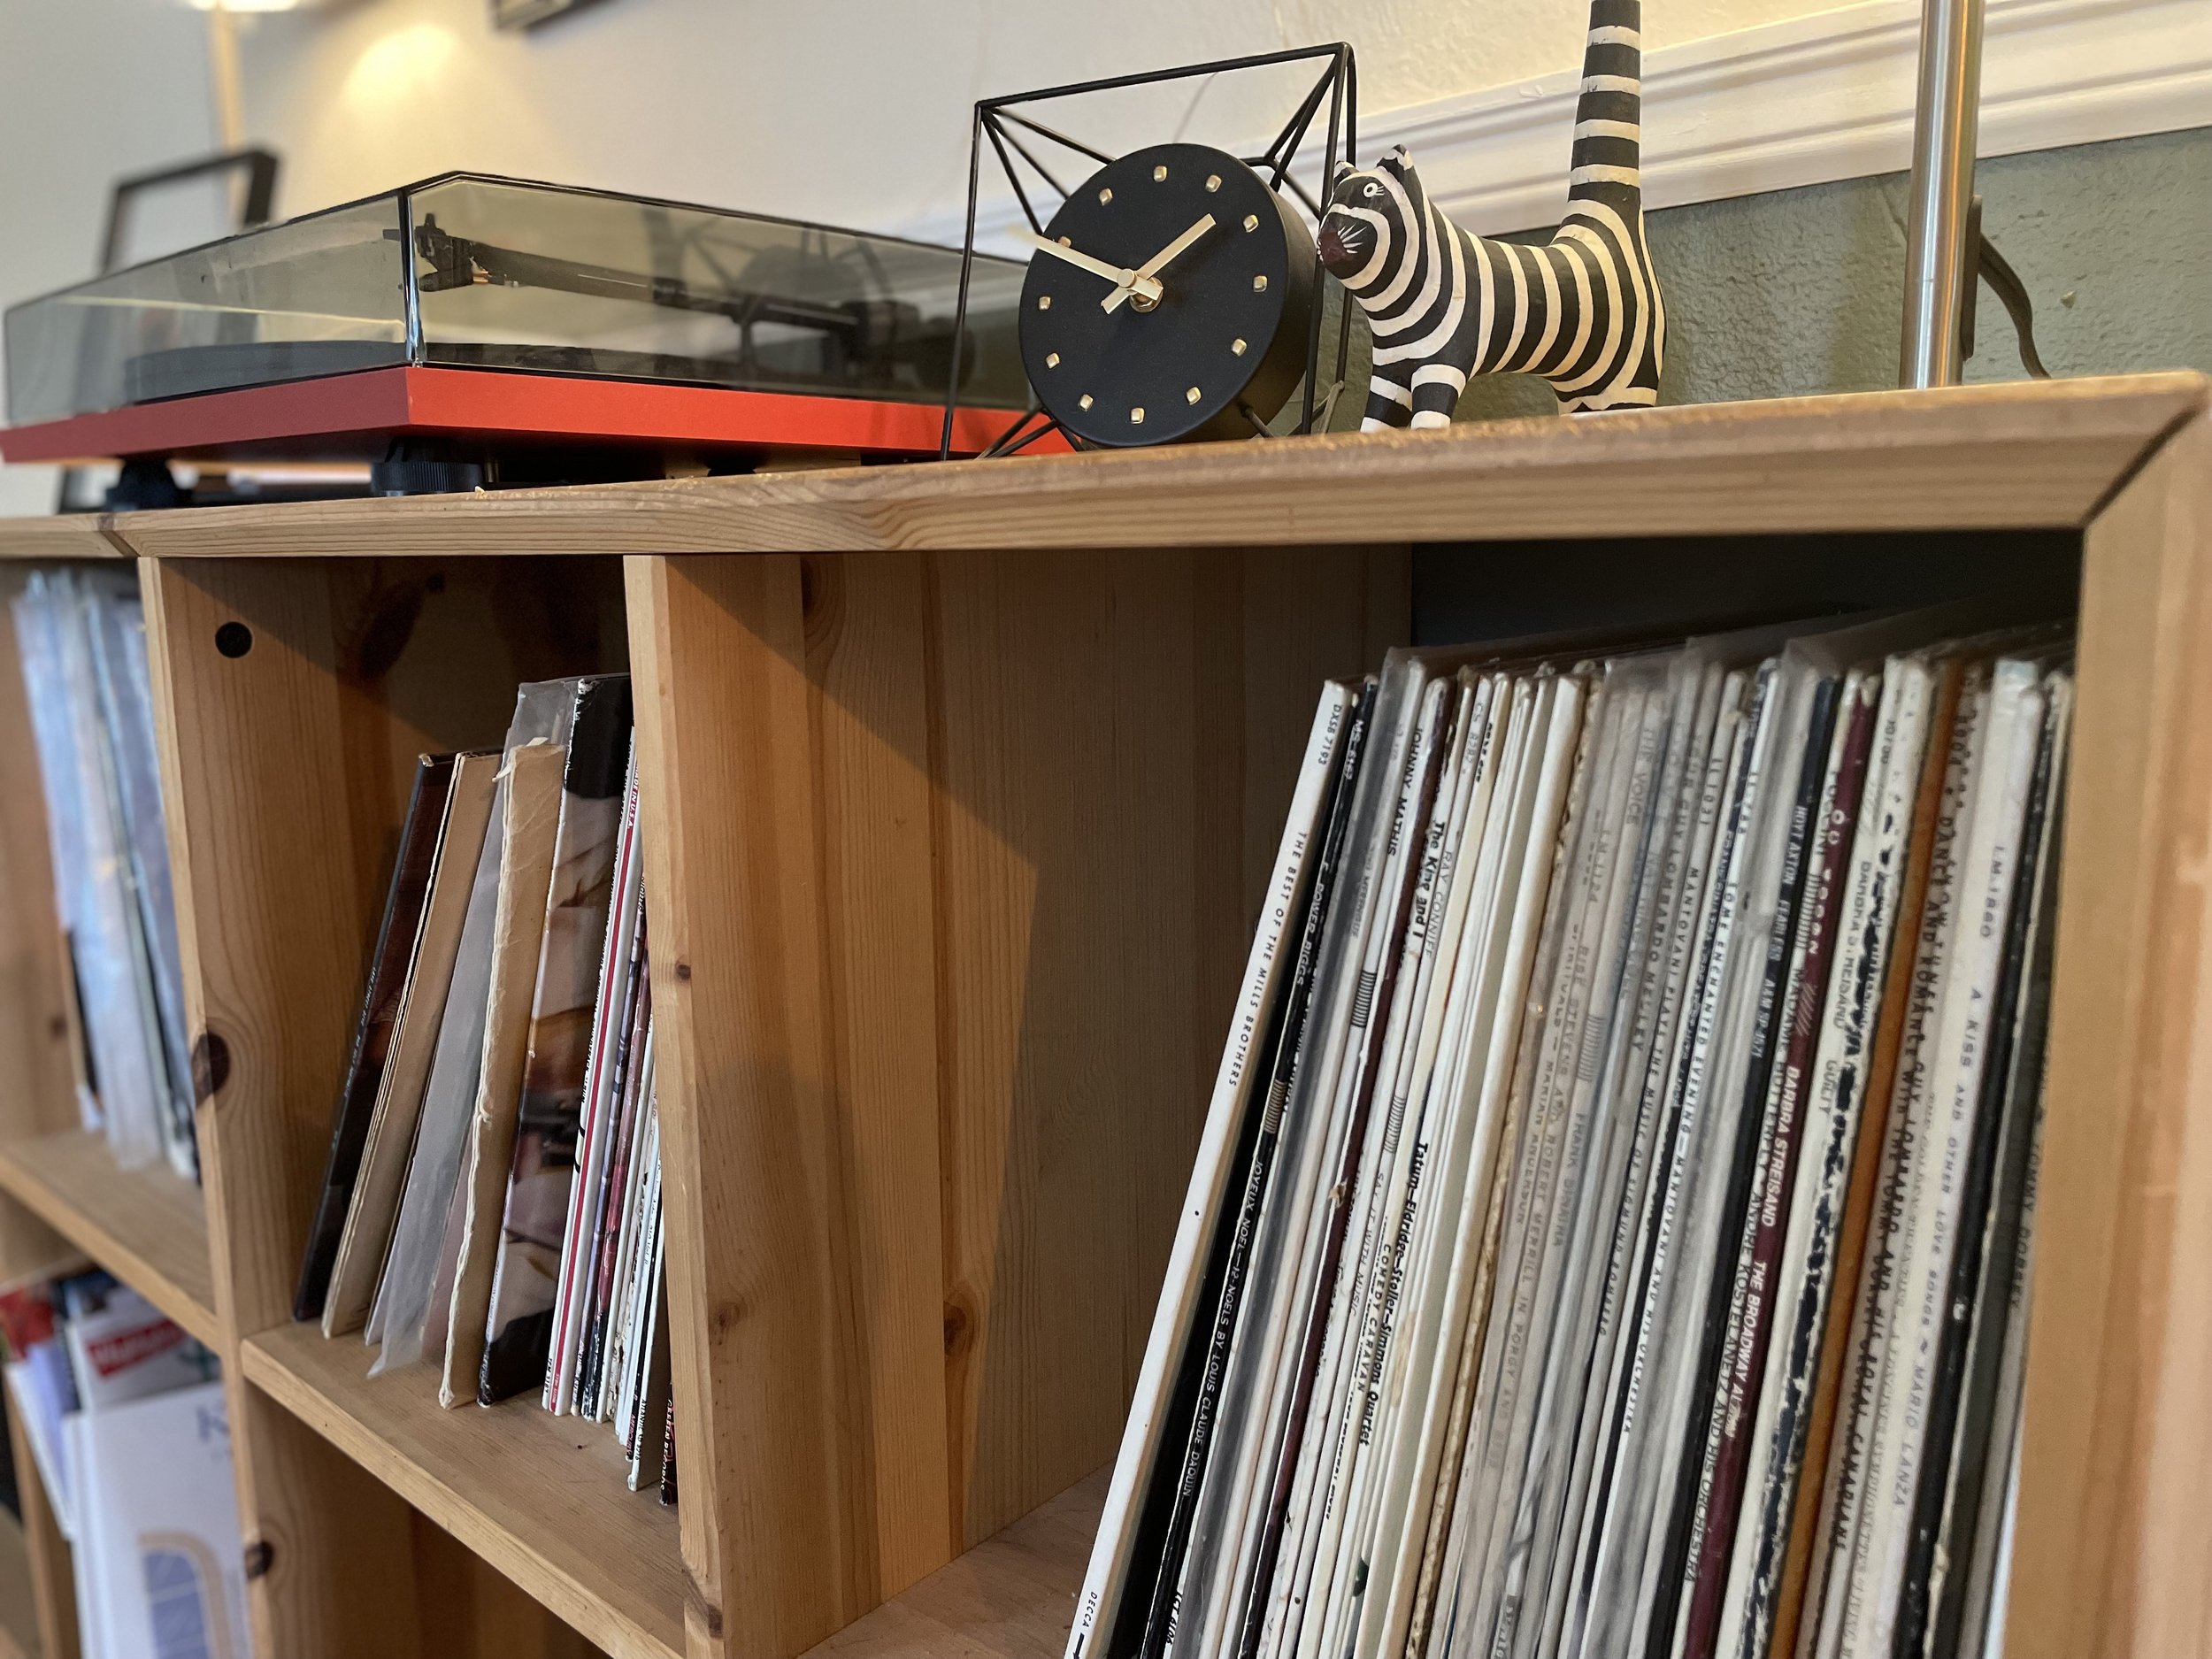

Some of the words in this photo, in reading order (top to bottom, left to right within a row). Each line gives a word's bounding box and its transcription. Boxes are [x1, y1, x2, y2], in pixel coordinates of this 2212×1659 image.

[1326, 704, 1341, 733] DXSB
[1317, 739, 1332, 764] 7193
[1402, 728, 1424, 787] JOHNNY
[1638, 728, 1656, 762] THE
[627, 803, 637, 829] U.S.A.
[631, 792, 637, 803] IN
[1625, 772, 1648, 825] VOICE
[1671, 799, 1691, 837] GUY
[1291, 832, 1306, 857] THE
[1386, 797, 1408, 856] MATHIS
[1428, 821, 1445, 849] The
[1789, 805, 1809, 840] HOYT
[1417, 856, 1438, 890] King
[1436, 852, 1453, 881] RAY
[1781, 841, 1802, 885] AXTON
[1928, 817, 1955, 886] DANCE
[1279, 866, 1296, 899] BEST
[1272, 908, 1286, 926] OF
[1412, 897, 1431, 925] and
[1423, 892, 1443, 957] CONNIFF
[1645, 849, 1681, 962] LOMBARDO
[1667, 867, 1700, 976] MANTOVANI
[1717, 881, 1739, 930] SOME
[1921, 902, 1941, 941] AND
[1262, 934, 1276, 959] THE
[1766, 899, 1793, 961] FEARLESS
[1294, 941, 1312, 985] BIGGS
[1248, 968, 1267, 1008] MILLS
[1695, 941, 1726, 1044] ENCHANTED
[1758, 979, 1776, 1009] A&M
[1903, 956, 1932, 1056] ROMANCE
[1970, 987, 1984, 1000] A
[1655, 986, 1676, 1036] PLAYS
[1229, 1015, 1253, 1086] BROTHERS
[1555, 999, 1580, 1075] STEVENS
[1959, 1019, 1979, 1067] KISS
[1647, 1047, 1663, 1076] THE
[1908, 1063, 1926, 1102] GUY
[1774, 1065, 1801, 1133] BARBRA
[1816, 1059, 1839, 1115] GUILTY
[1951, 1083, 1966, 1120] AND
[1634, 1087, 1655, 1141] MUSIC
[1533, 1134, 1557, 1202] ROBERT
[1629, 1149, 1643, 1169] OF
[1939, 1136, 1959, 1194] OTHER
[1244, 1159, 1263, 1210] JOYEUX
[1373, 1173, 1385, 1192] SAY
[1758, 1138, 1790, 1227] STREISAND
[1367, 1208, 1378, 1220] IT
[1612, 1179, 1637, 1253] SIGMUND
[1929, 1209, 1947, 1254] LOVE
[1358, 1230, 1373, 1264] WITH
[1519, 1213, 1544, 1282] MERRILL
[1347, 1272, 1365, 1316] MUSIC
[1370, 1244, 1393, 1310] COMEDY
[1647, 1268, 1663, 1302] AND
[1747, 1260, 1767, 1291] THE
[1919, 1269, 1938, 1325] SONGS
[1517, 1296, 1530, 1311] IN
[1641, 1310, 1654, 1335] HIS
[1213, 1331, 1226, 1348] BY
[1716, 1263, 1753, 1393] KOSTELANETZ
[1732, 1294, 1762, 1381] BROADWAY
[1204, 1354, 1222, 1391] LOUIS
[1354, 1317, 1379, 1393] CARAVAN
[1503, 1324, 1524, 1377] PORGY
[1496, 1388, 1512, 1418] AND
[1622, 1343, 1647, 1432] ORCHESTRA
[1855, 1354, 1878, 1417] ROYAL
[1903, 1363, 1925, 1428] MARIO
[638, 1398, 647, 1431] ATLANTIC
[1192, 1396, 1212, 1444] CLAUDE
[1356, 1391, 1379, 1445] Quartet
[1708, 1401, 1728, 1438] AND
[1180, 1451, 1201, 1496] DAQUIN
[1701, 1444, 1721, 1473] HIS
[1892, 1441, 1915, 1506] LANZA
[1833, 1432, 1865, 1549] CANADIANS
[1682, 1479, 1714, 1582] ORCHESTRA
[1080, 1592, 1097, 1627] DECCA
